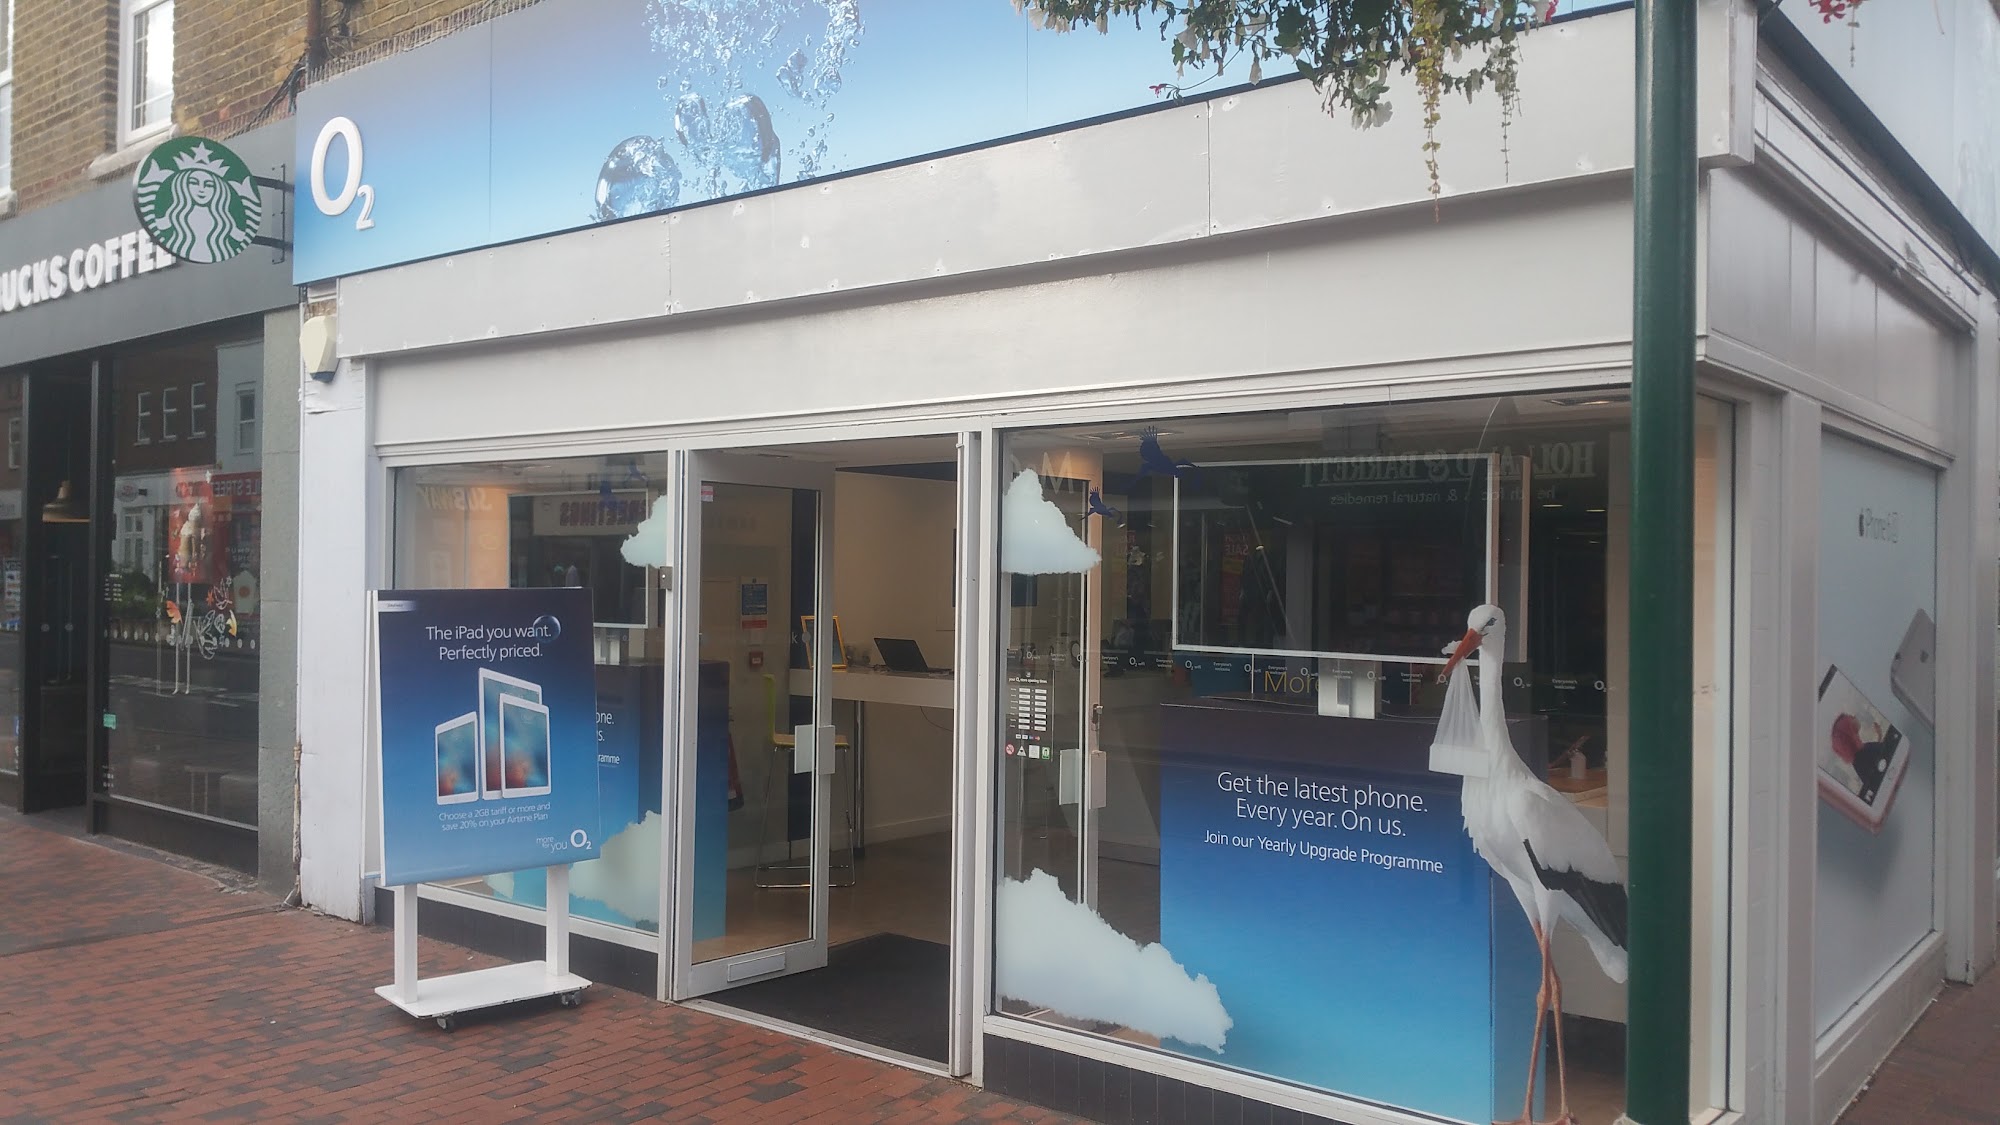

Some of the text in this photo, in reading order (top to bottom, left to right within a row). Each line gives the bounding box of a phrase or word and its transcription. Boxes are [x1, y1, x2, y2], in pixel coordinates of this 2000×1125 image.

[310, 116, 375, 230] O2
[0, 254, 68, 313] UCKS
[425, 624, 552, 643] The iPad you want.
[439, 642, 543, 662] Perfectly priced.
[1264, 671, 1319, 694] Mor
[596, 711, 615, 725] one.
[597, 730, 605, 742] s.
[598, 754, 620, 764] ramme
[1217, 771, 1428, 812] Get the latest phone.
[439, 812, 467, 821] Choose
[474, 808, 489, 818] 2GB
[490, 807, 507, 816] tariff
[517, 805, 535, 813] more
[536, 802, 551, 812] and
[1236, 797, 1406, 836] Every year. On us.
[441, 812, 549, 831] save 20% on your Airtime Plan
[536, 836, 554, 844] more
[550, 841, 568, 853] you
[570, 829, 592, 850] O2
[1204, 830, 1444, 873] Join our Yearly Upgrade Programme
